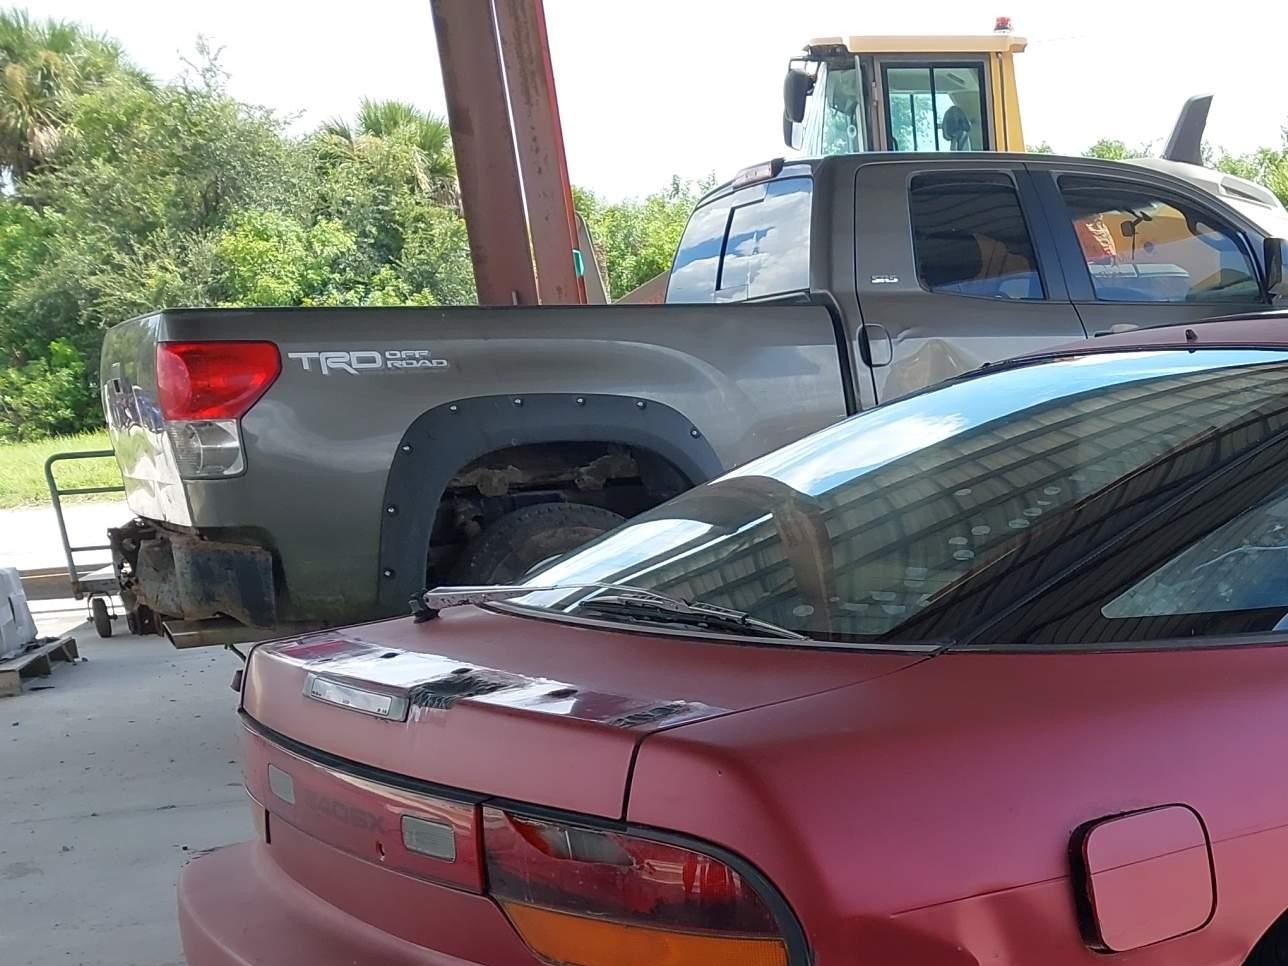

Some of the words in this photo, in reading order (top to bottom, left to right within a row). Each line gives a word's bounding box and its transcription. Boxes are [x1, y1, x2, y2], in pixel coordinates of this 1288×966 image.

[385, 350, 429, 359] OFF
[288, 351, 382, 375] TRD
[387, 359, 448, 369] ROAD
